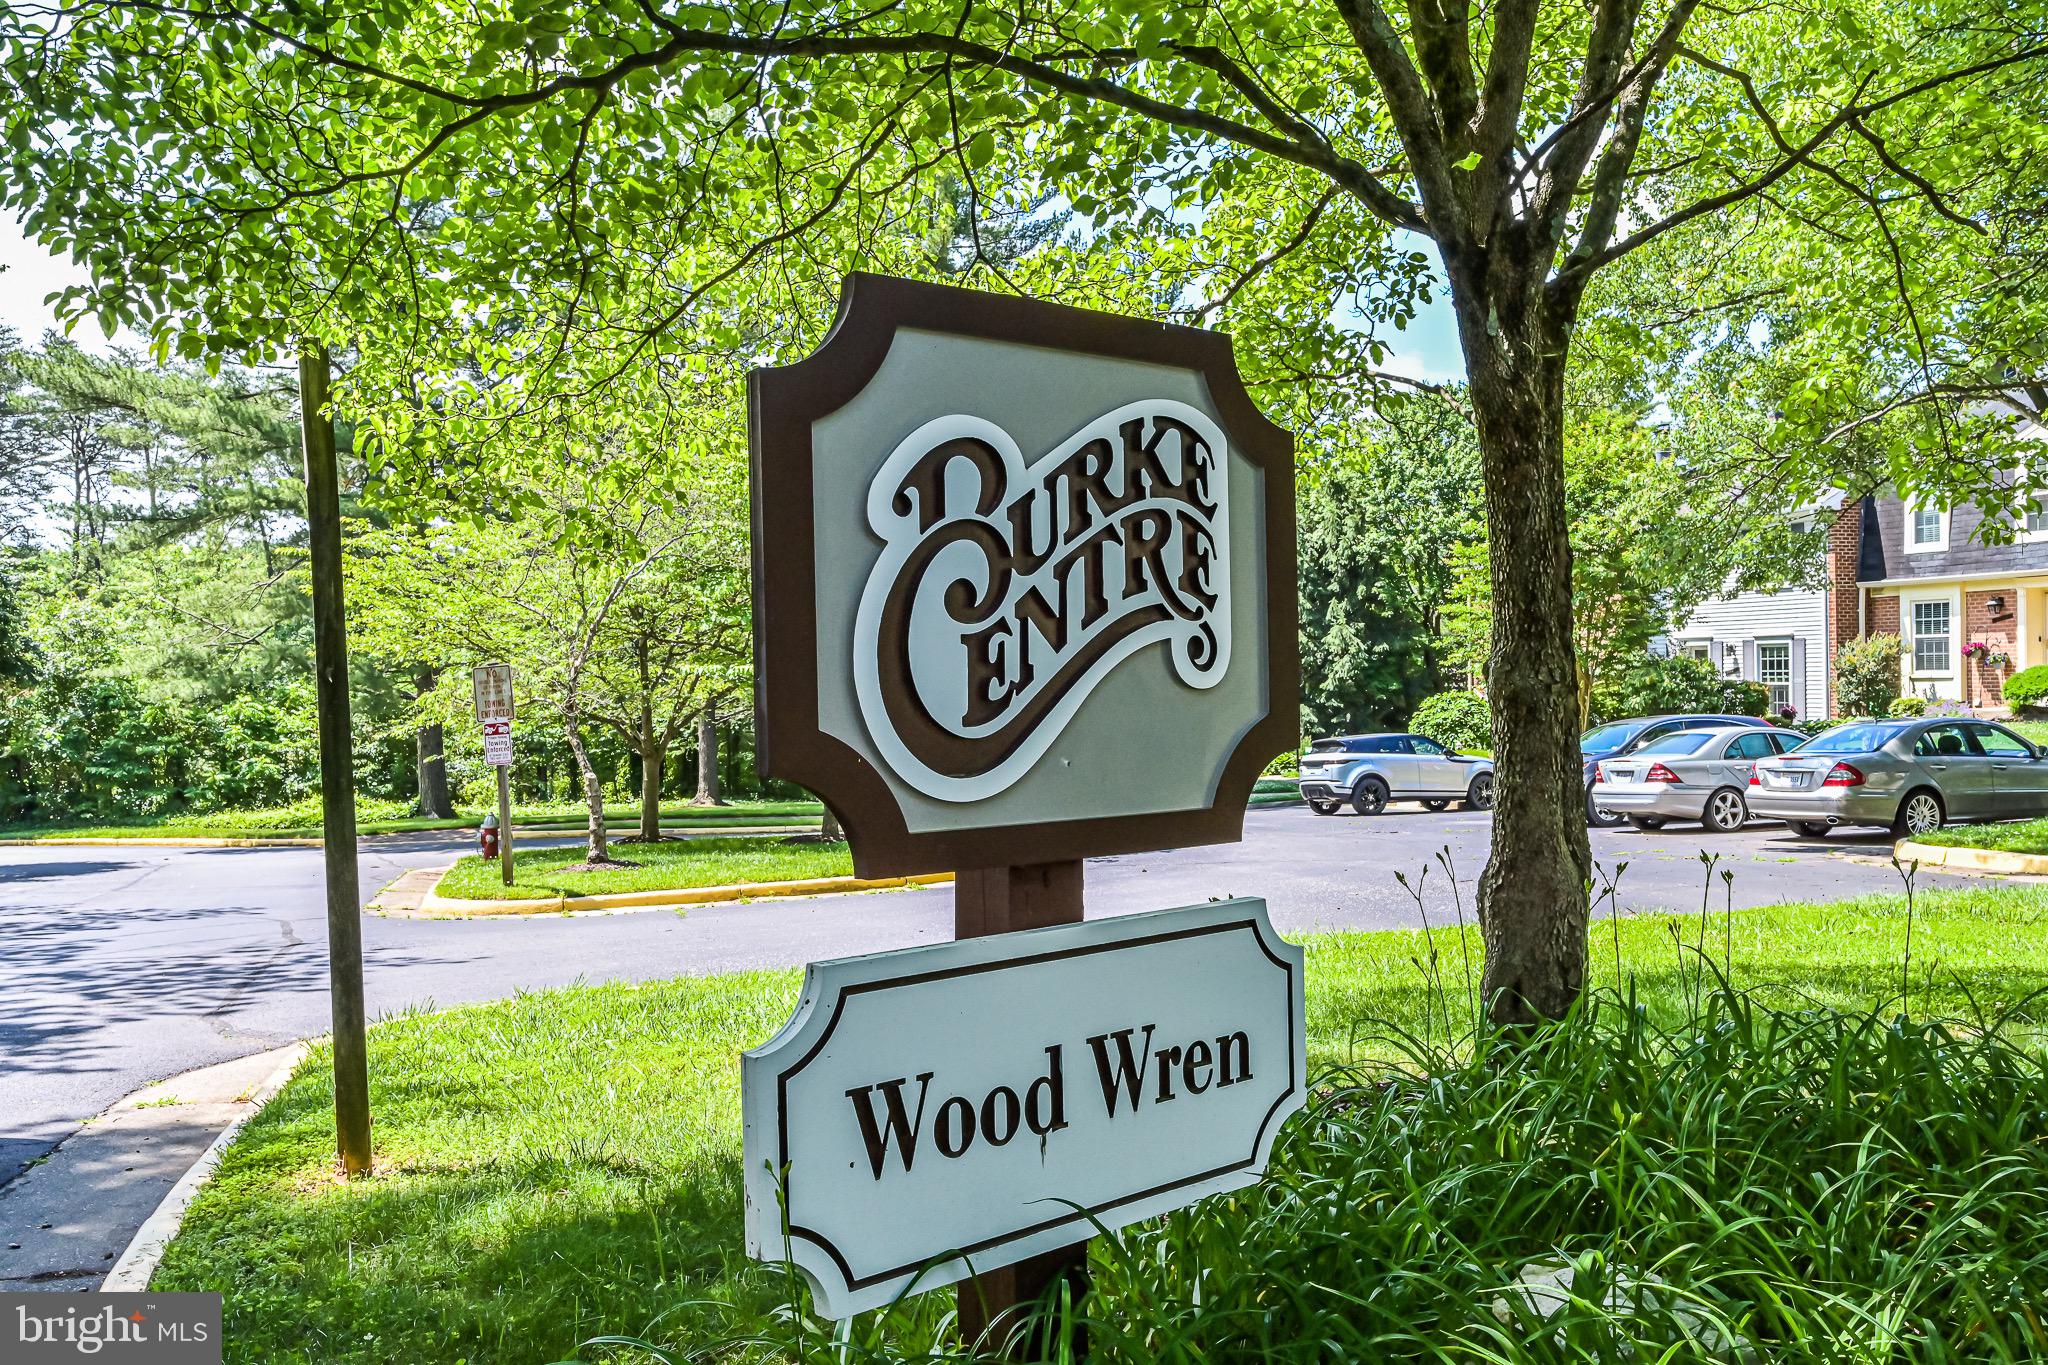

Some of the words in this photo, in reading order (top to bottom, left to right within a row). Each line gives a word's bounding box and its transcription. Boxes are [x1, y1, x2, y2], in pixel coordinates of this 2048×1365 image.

[892, 415, 1218, 577] BURKE
[486, 669, 498, 679] NO
[877, 508, 1218, 779] CENTRE
[480, 709, 510, 719] ENFORCED
[484, 699, 506, 709] TOWING
[845, 1044, 1069, 1181] Wood
[1086, 1024, 1254, 1119] Wren
